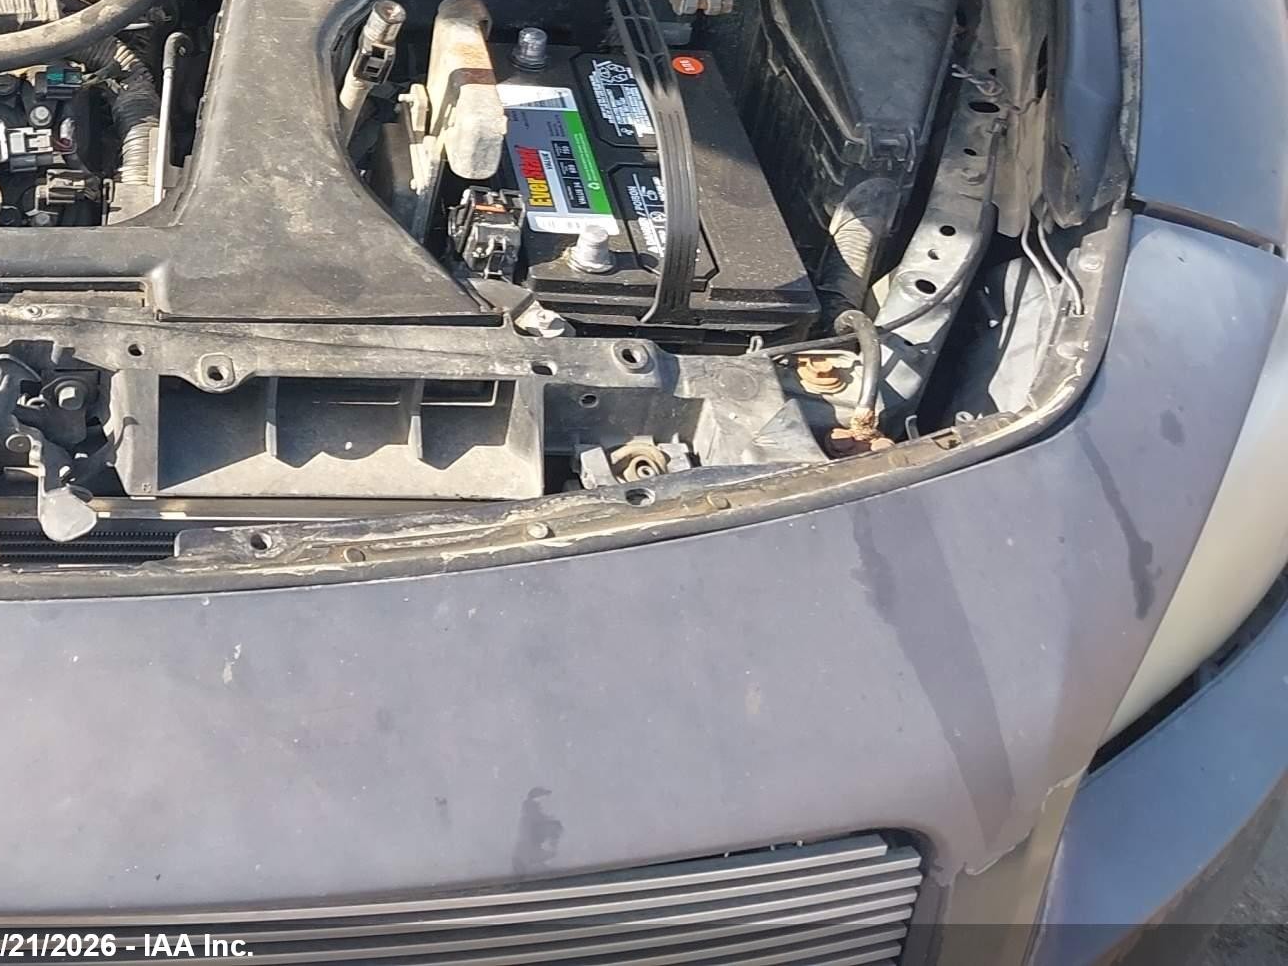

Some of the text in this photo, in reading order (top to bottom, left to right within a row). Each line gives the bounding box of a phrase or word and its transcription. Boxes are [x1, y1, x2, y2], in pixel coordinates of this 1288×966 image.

[540, 152, 554, 171] VALUE
[517, 146, 554, 207] EverStart
[626, 186, 645, 211] POISON
